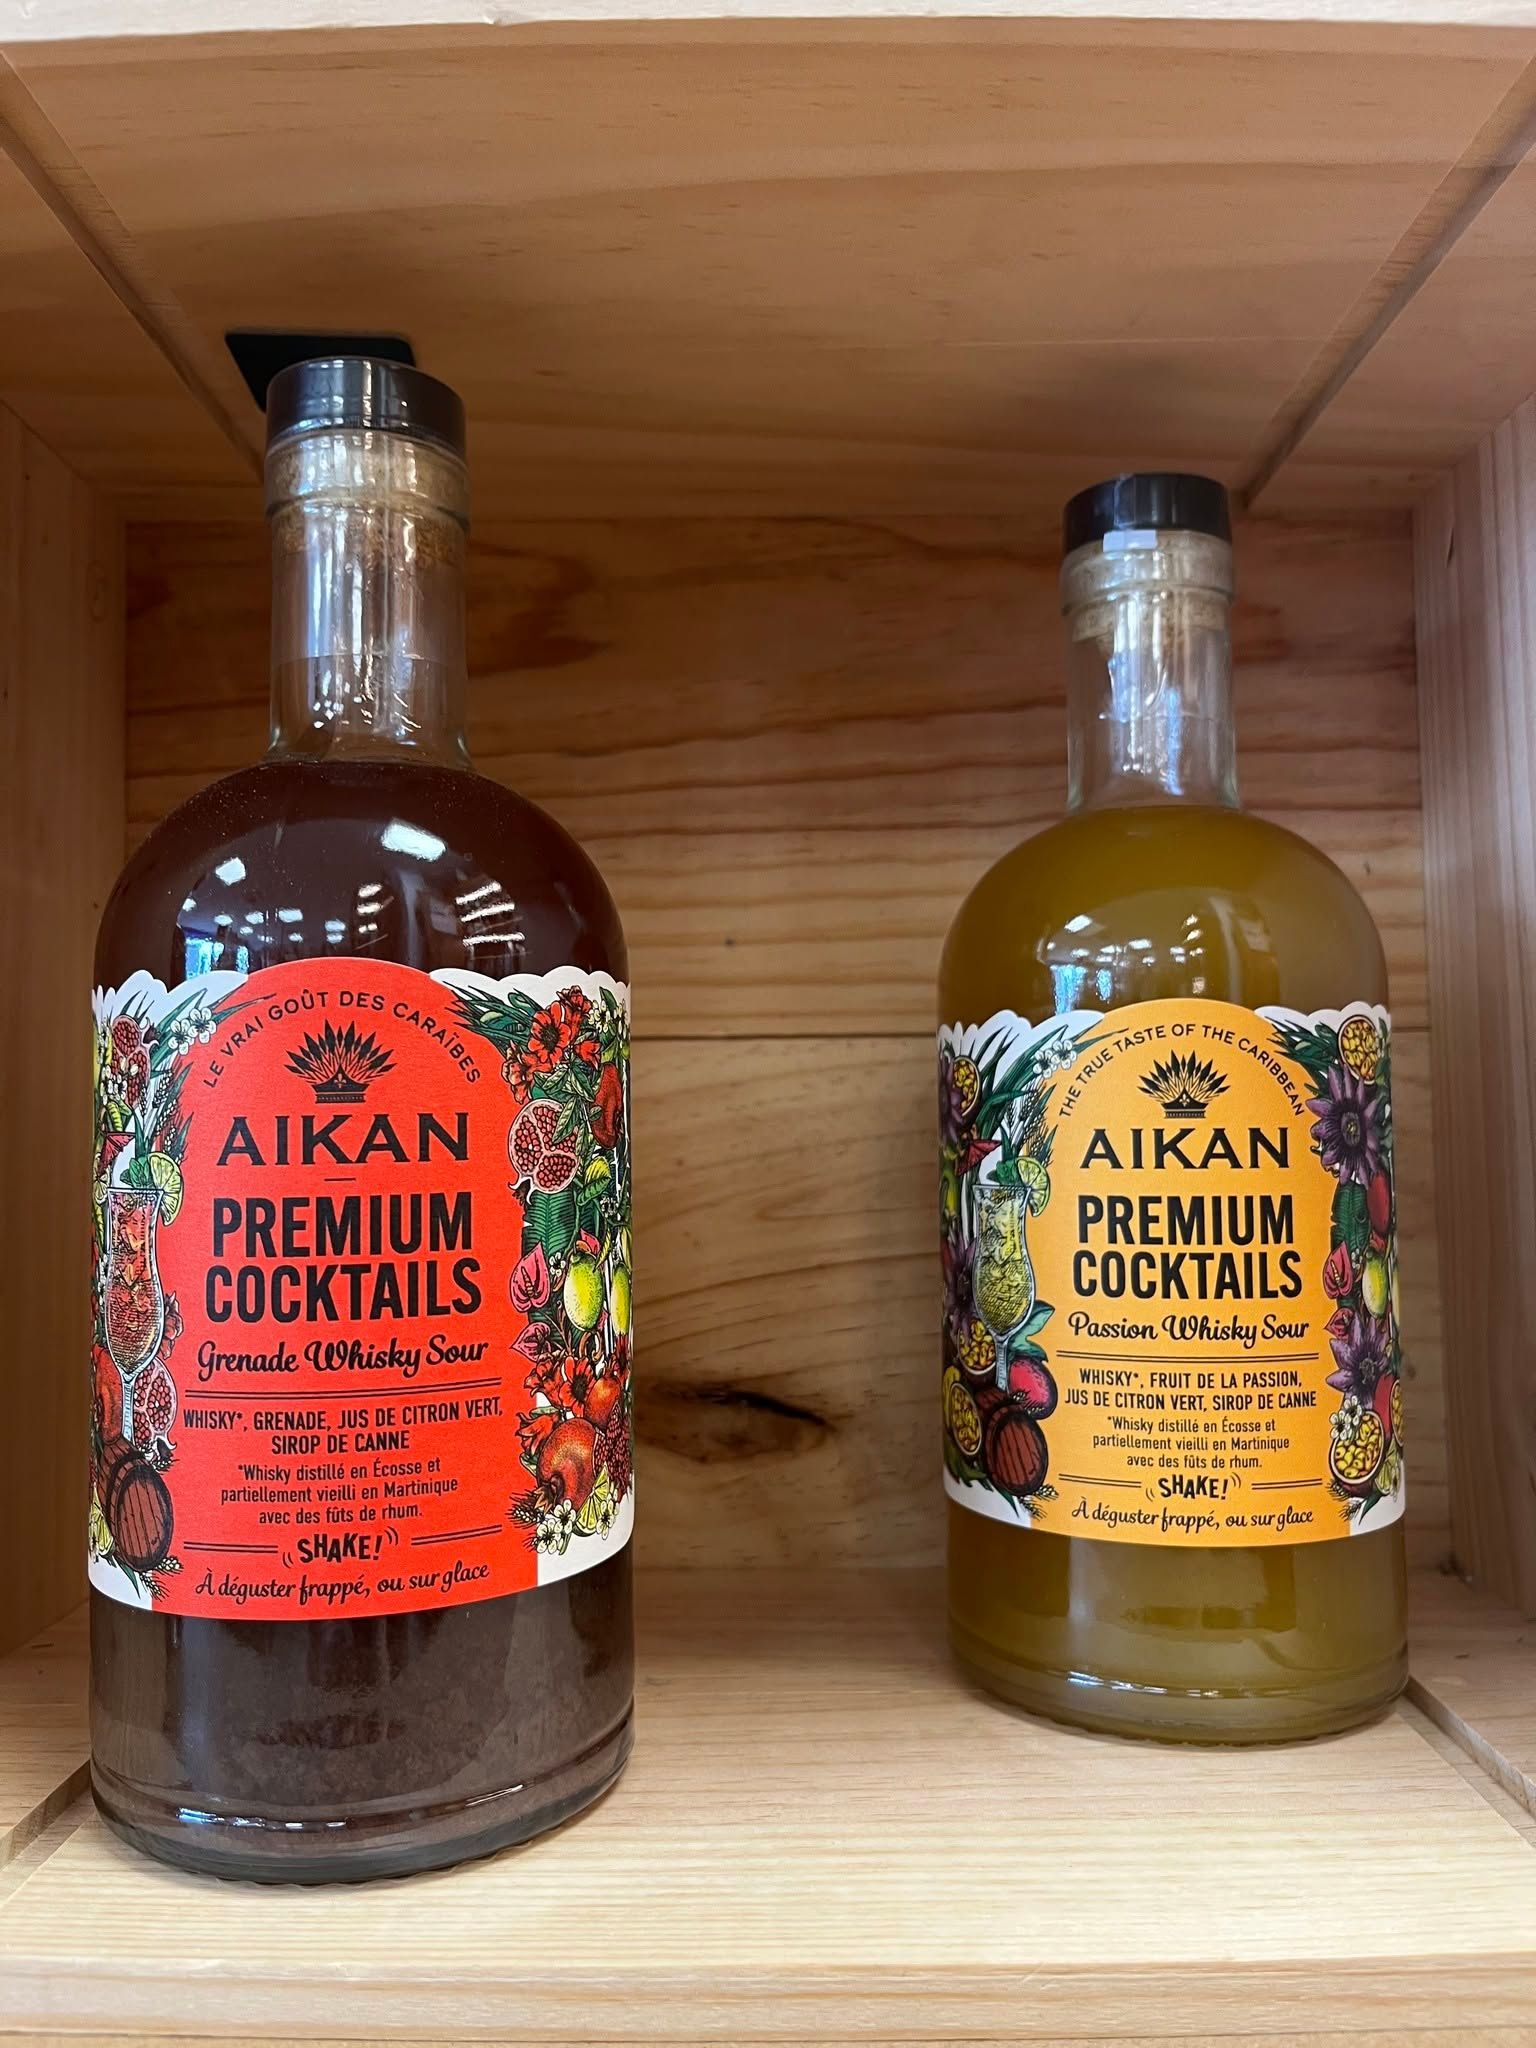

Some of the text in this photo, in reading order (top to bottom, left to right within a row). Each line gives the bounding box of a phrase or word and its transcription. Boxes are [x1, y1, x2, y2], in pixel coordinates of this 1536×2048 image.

[203, 989, 480, 1088] LE VRAI GOÛT DES CARAÏBES
[1059, 1024, 1305, 1116] THE TRUE TASTE OF THE CARIBBEAN
[216, 1112, 469, 1166] AIKAN
[1080, 1127, 1289, 1169] AIKAN
[213, 1192, 472, 1258] PREMIUM
[1078, 1194, 1294, 1246] PREMIUM
[206, 1257, 482, 1323] COCKTAILS
[1073, 1250, 1302, 1300] COCKTAILS
[1068, 1311, 1309, 1349] Passion Whisky Sour
[198, 1334, 489, 1382] Grenade Whisky Sour
[1150, 1372, 1191, 1389] FRUIT
[1197, 1373, 1215, 1389] DE
[1221, 1373, 1238, 1389] LA
[1243, 1371, 1302, 1388] PASSION,
[254, 1411, 331, 1431] GRENADE,
[337, 1409, 369, 1429] JUS
[376, 1408, 395, 1427] DE
[402, 1402, 459, 1425] CITRON
[465, 1397, 502, 1418] VERT,
[1065, 1388, 1317, 1412] JUS DE CITRON VERT, SIROP DE CANNE
[1158, 1419, 1199, 1433] distillé
[1204, 1423, 1217, 1433] en
[1222, 1416, 1261, 1433] Écosse
[1265, 1419, 1275, 1431] et
[272, 1430, 409, 1455] SIROP DE CANNE
[1093, 1435, 1289, 1452] partiellement vieilli en Martinique
[297, 1464, 344, 1481] distillé
[350, 1466, 367, 1479] en
[374, 1457, 422, 1477] Écosse
[428, 1458, 440, 1472] et
[1127, 1454, 1262, 1468] avec des fûts de rhum.
[221, 1479, 458, 1505] partiellement vieilli en Martinique
[1158, 1474, 1228, 1500] SHAKE!
[259, 1504, 423, 1524] avec des fûts de rhum.
[1072, 1497, 1313, 1534] À déguster frappé, ou sur glace
[297, 1533, 382, 1563] SHAKE!
[195, 1560, 489, 1605] À déguster frappé, ou sur glace
